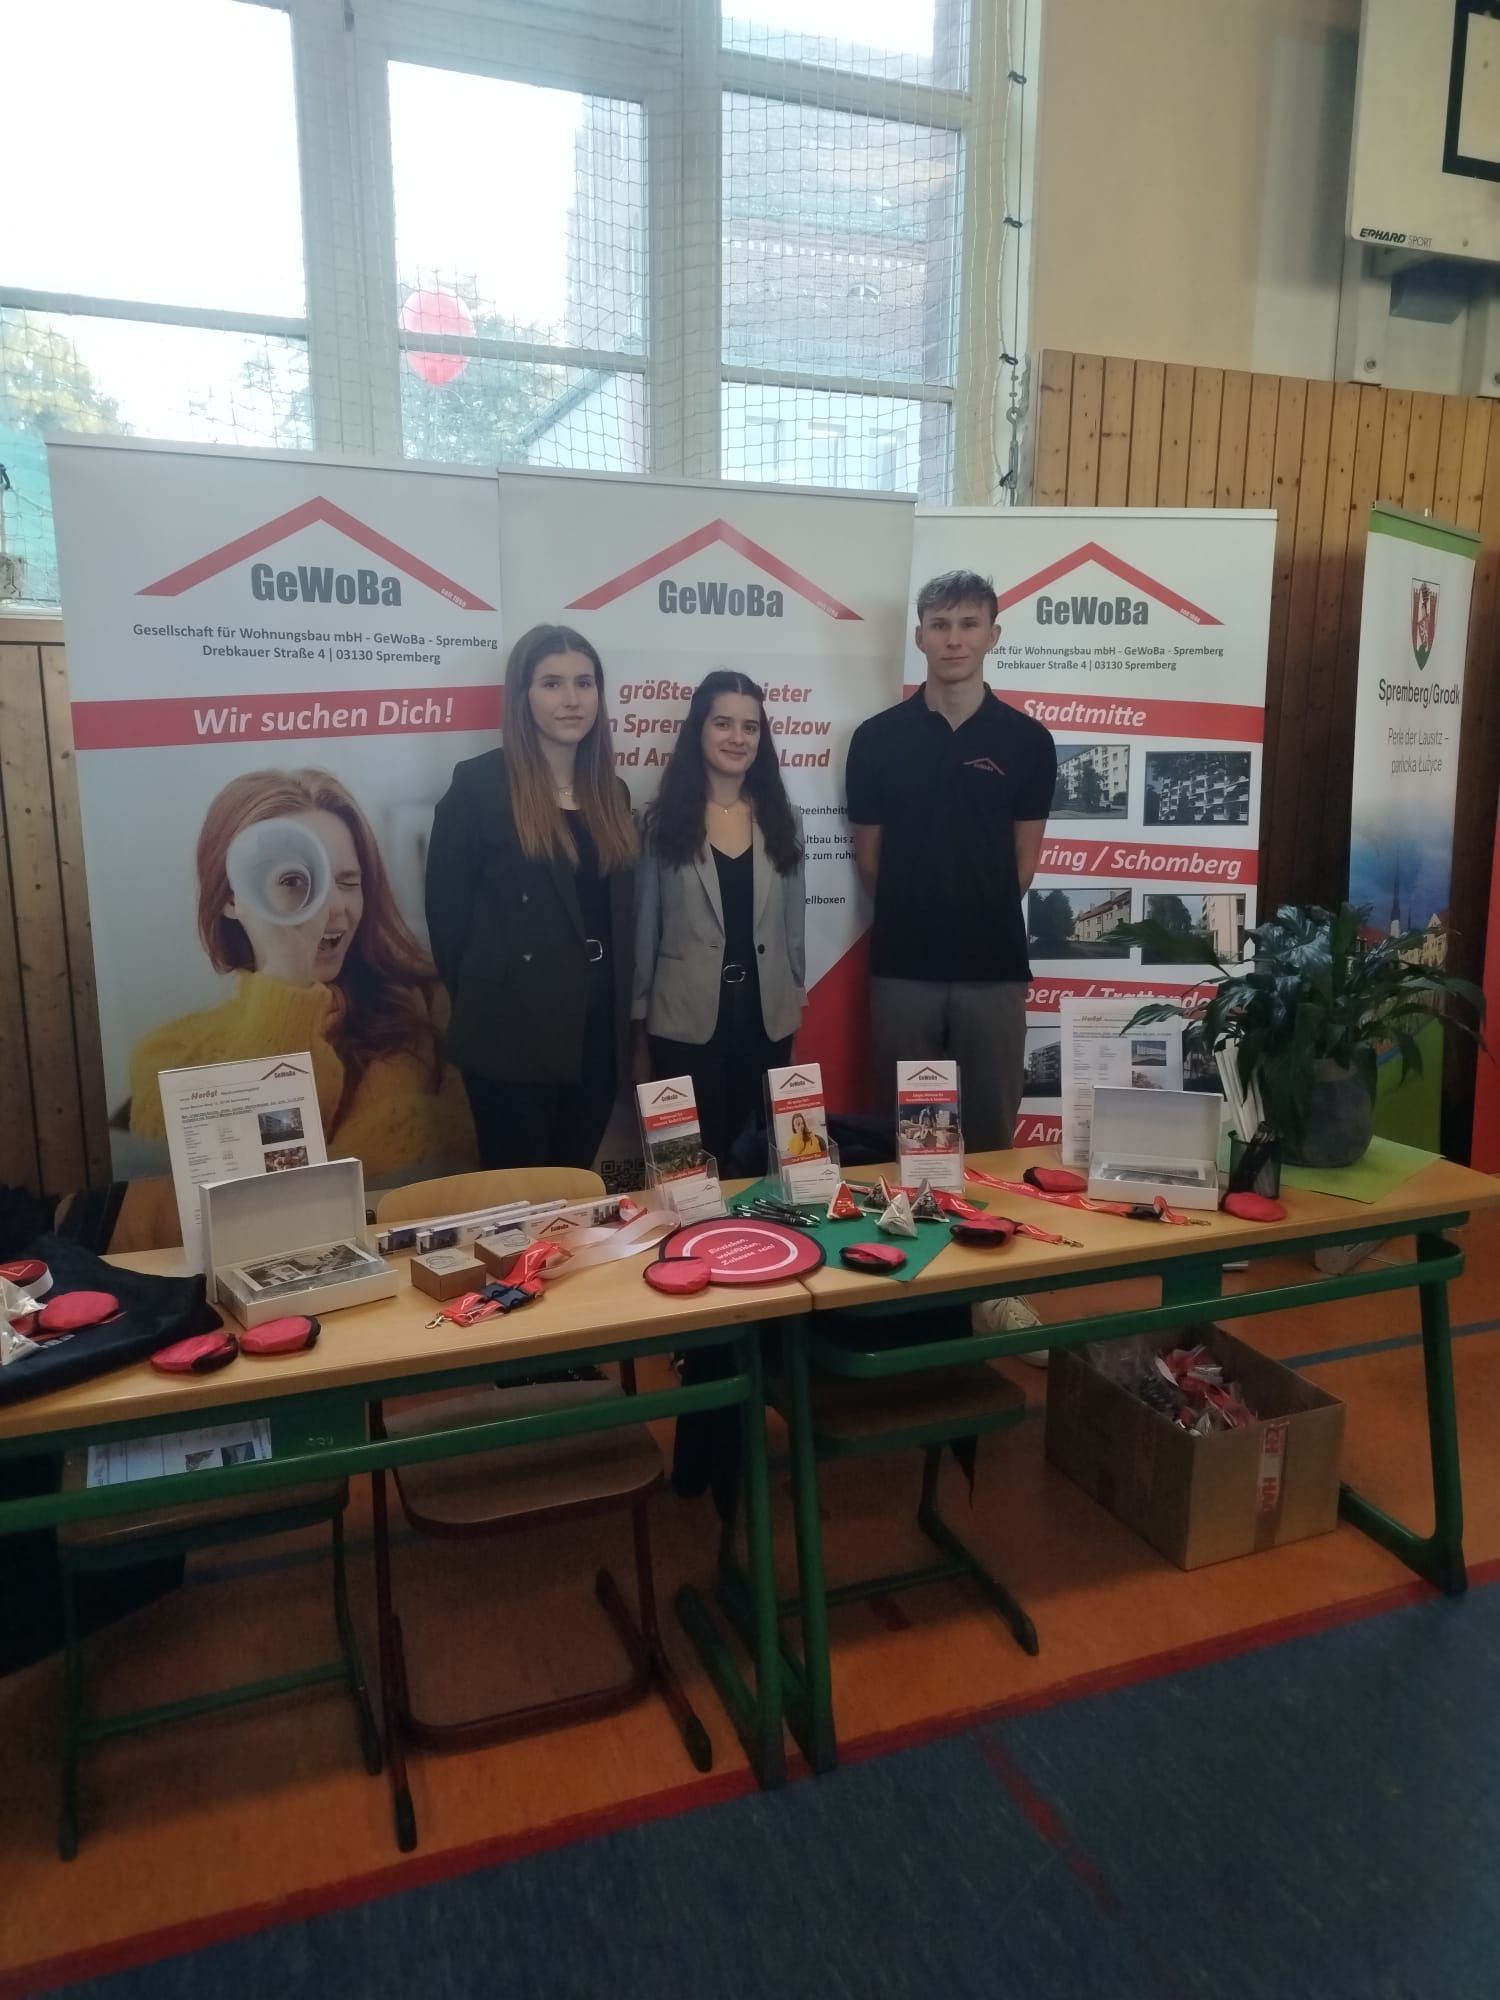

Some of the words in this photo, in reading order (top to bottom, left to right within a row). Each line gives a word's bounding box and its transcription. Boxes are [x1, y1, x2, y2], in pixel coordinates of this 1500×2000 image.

[251, 563, 402, 607] GeWoBa
[658, 579, 784, 618] GeWoBa
[1036, 596, 1150, 626] GeWoBa
[133, 624, 214, 638] Gesellschaft
[217, 625, 236, 638] für
[239, 627, 330, 643] Wohnungsbau
[334, 631, 363, 643] mbH
[374, 632, 425, 645] GeWoBa
[436, 635, 498, 650] Spremberg
[202, 645, 271, 658] Drebkauer
[274, 647, 315, 659] Straße
[318, 649, 326, 659] 4
[336, 649, 373, 661] 03130
[376, 650, 441, 665] Spremberg
[1009, 645, 1023, 656] für
[1025, 645, 1092, 657] Wohnungsbau
[1094, 645, 1116, 656] mbH
[1124, 646, 1165, 656] GeWoBa
[1173, 645, 1224, 657] Spremberg
[997, 660, 1046, 670] Drebkauer
[1048, 660, 1079, 670] Straße
[1081, 660, 1087, 670] 4
[1094, 660, 1123, 670] 03130
[1125, 660, 1177, 672] Spremberg
[619, 680, 698, 705] größte
[763, 682, 813, 703] ieter
[1379, 678, 1460, 709] Spremberg/Grodk
[193, 706, 252, 735] Wir
[260, 702, 368, 732] suchen
[378, 697, 454, 727] Dich!
[623, 713, 685, 738] Spre
[769, 715, 832, 736] elzow
[1024, 699, 1147, 727] Stadtmitte
[615, 747, 641, 767] nd
[780, 748, 831, 768] Land
[805, 834, 831, 844] ltbau
[834, 834, 848, 844] bis
[812, 852, 833, 861] zum
[1040, 845, 1088, 872] ring
[1090, 846, 1110, 872] /
[1110, 849, 1242, 880] Schomberg
[805, 895, 846, 905] ellboxen
